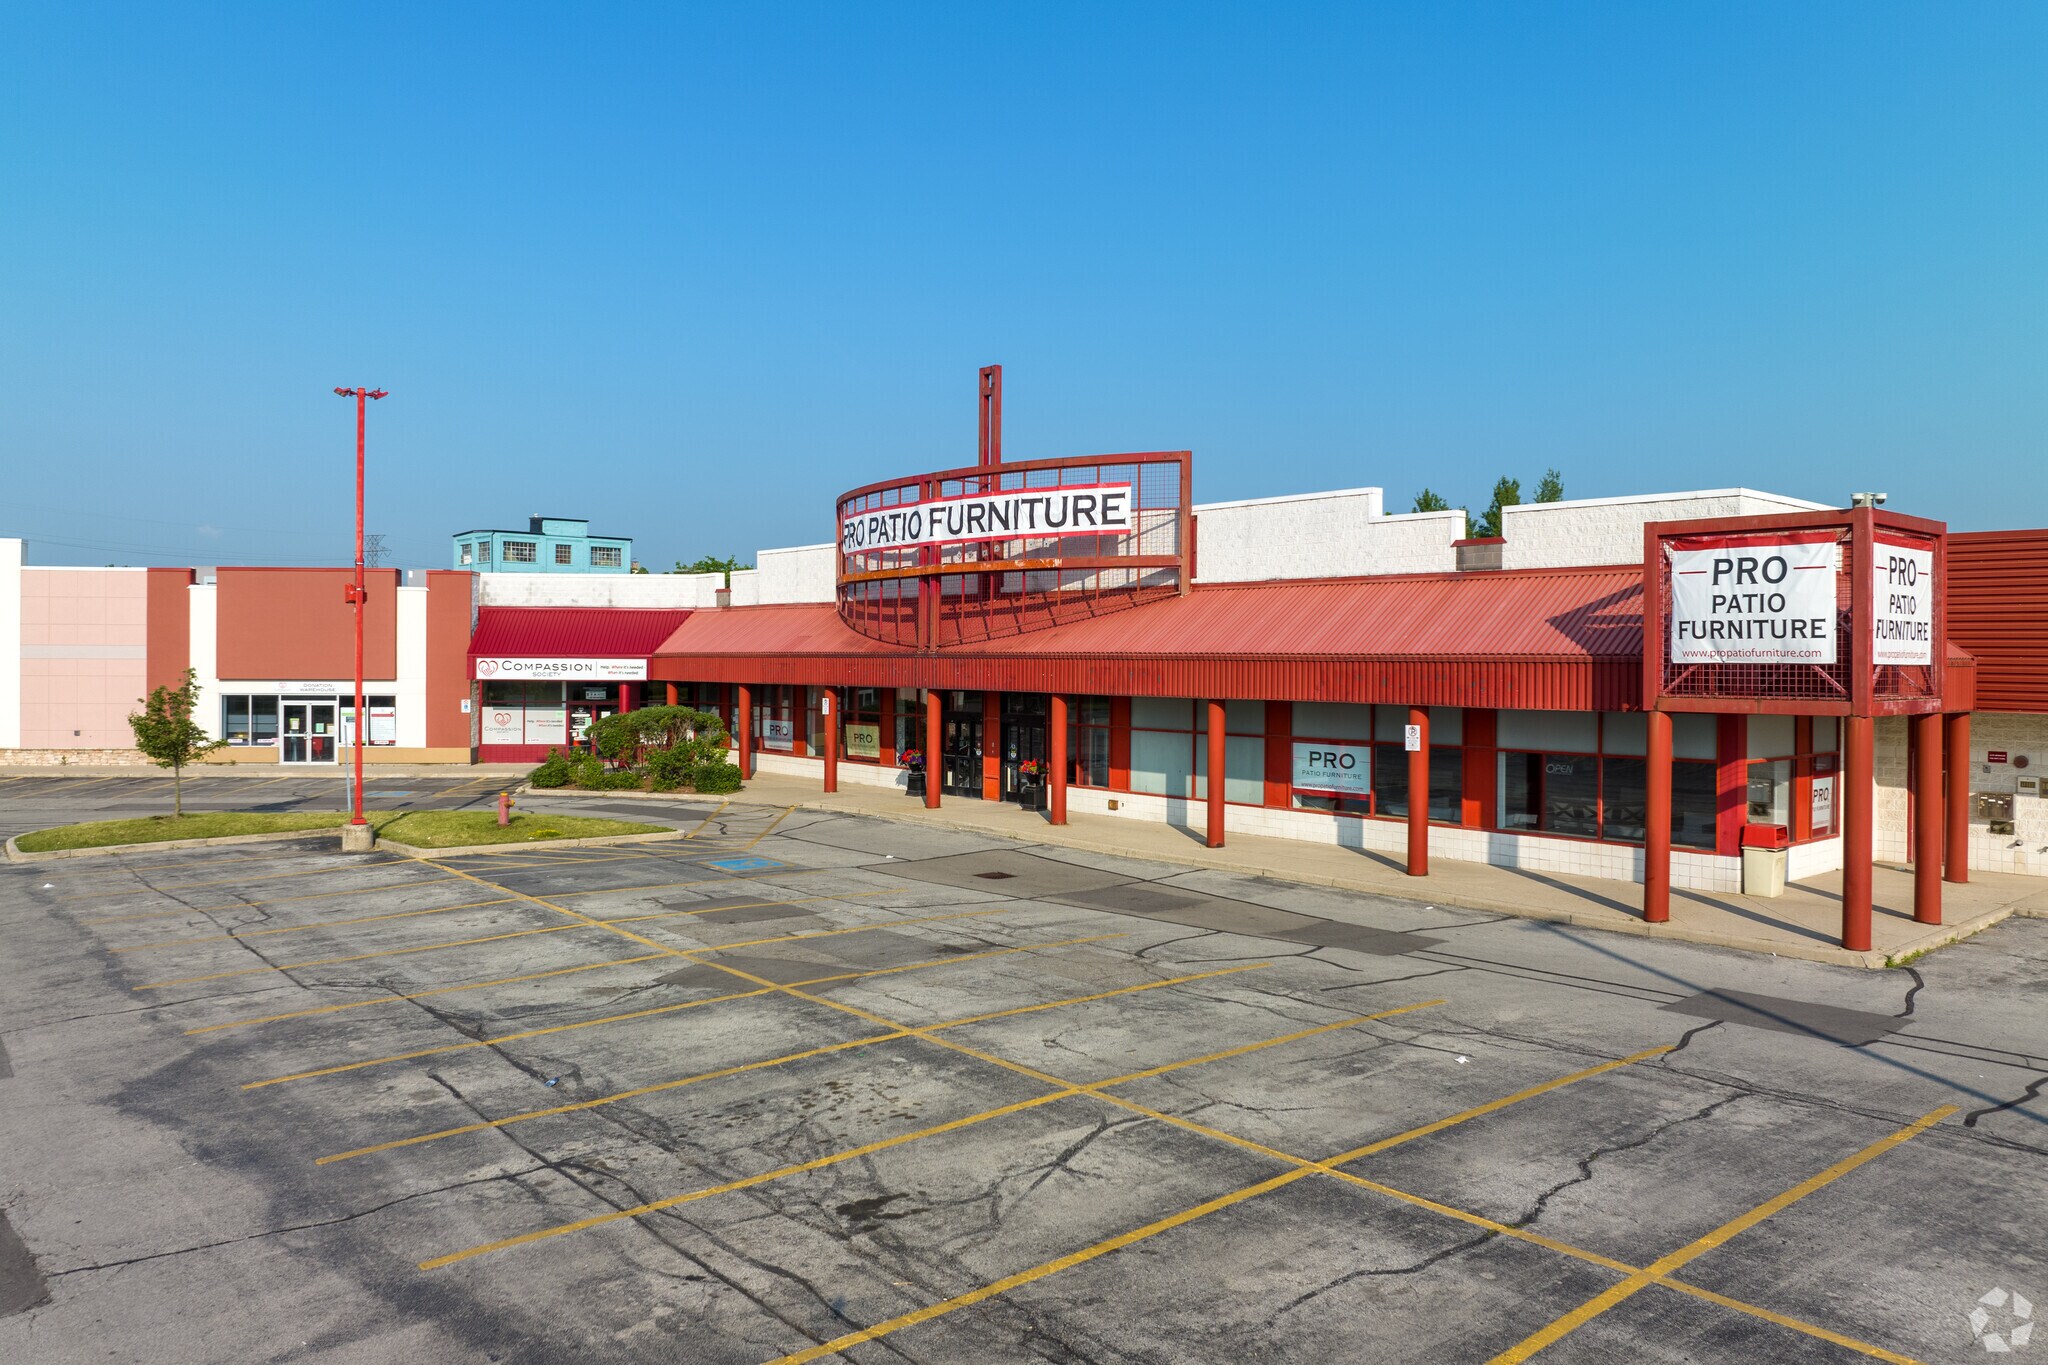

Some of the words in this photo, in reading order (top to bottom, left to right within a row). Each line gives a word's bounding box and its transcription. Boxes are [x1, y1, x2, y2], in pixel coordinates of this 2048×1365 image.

[843, 521, 866, 550] PRO
[868, 510, 922, 548] PATIO
[929, 492, 1127, 537] FURNITURE
[1712, 555, 1788, 586] PRO
[1889, 555, 1917, 587] PRO
[1711, 592, 1786, 614] PATIO
[1889, 593, 1917, 615] PATIO
[1678, 618, 1827, 640] FURNITURE
[1875, 617, 1929, 642] FURNITURE
[1681, 647, 1822, 660] www.propatiofurniture.com
[769, 724, 789, 737] PRO
[853, 733, 873, 744] PRO
[1309, 750, 1356, 770] PRO
[1545, 763, 1574, 775] OPEN
[1301, 769, 1321, 777] PATIO
[1322, 771, 1362, 780] FURNITURE
[1301, 782, 1364, 792] www.propatiofurniture.com
[1812, 786, 1829, 804] PRO
